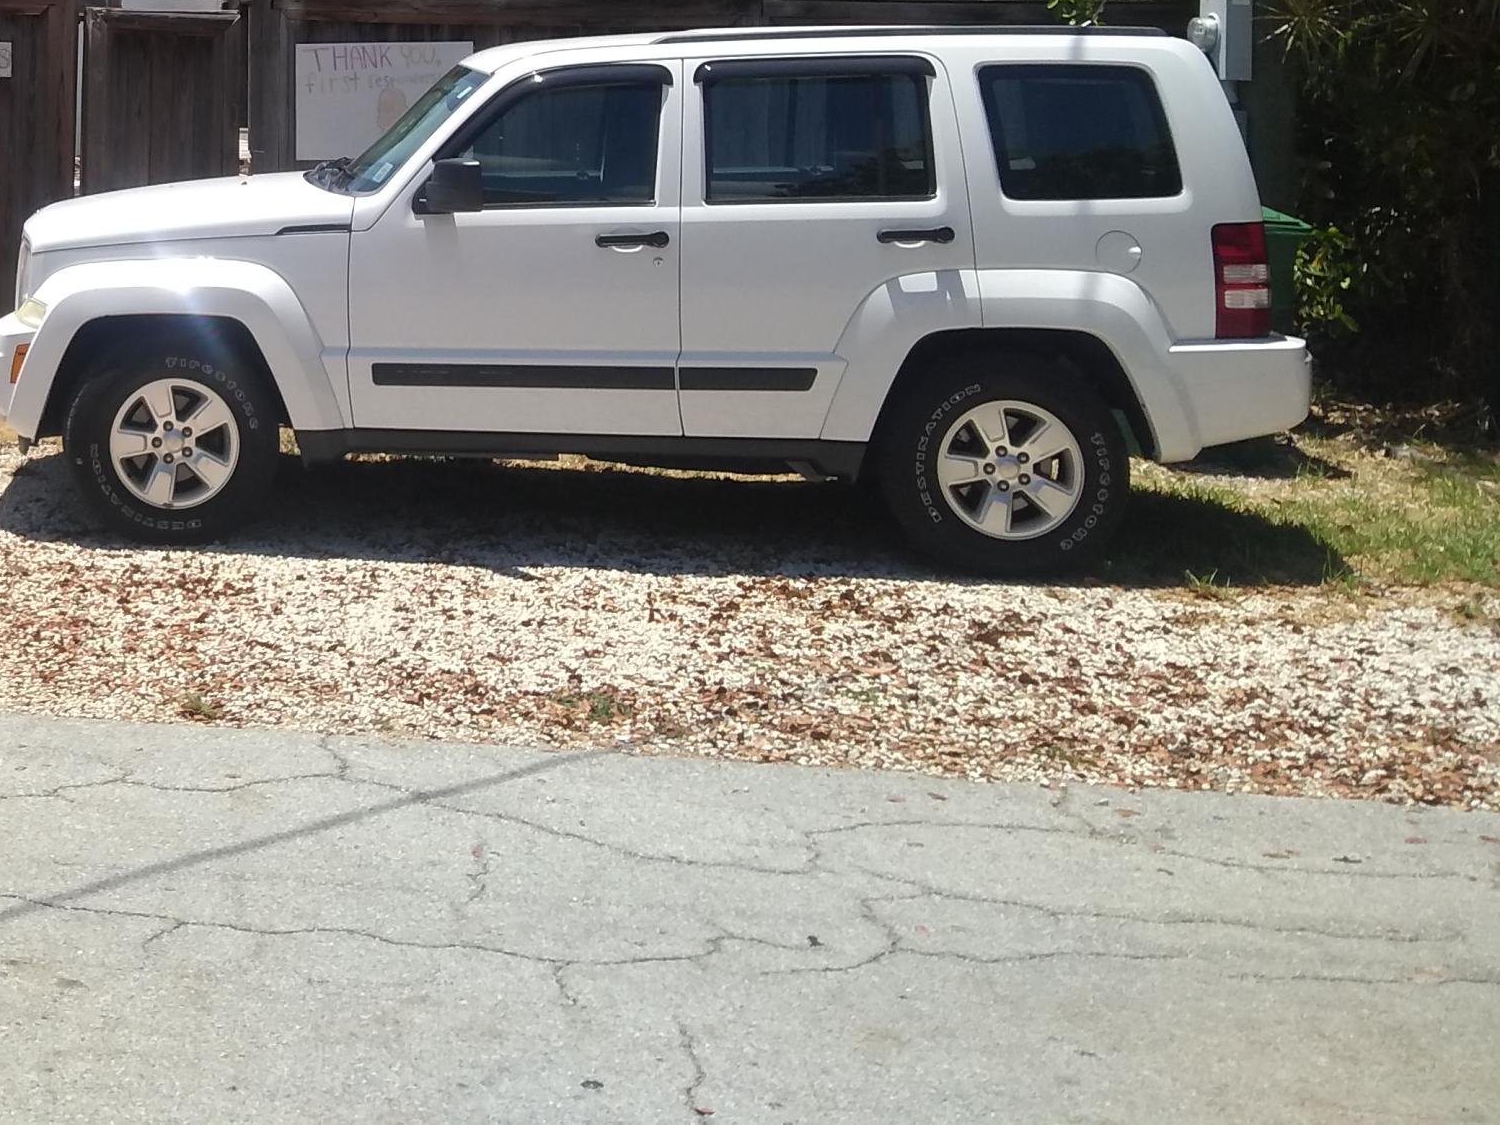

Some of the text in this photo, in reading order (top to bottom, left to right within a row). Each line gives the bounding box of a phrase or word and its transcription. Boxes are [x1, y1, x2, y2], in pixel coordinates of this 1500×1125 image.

[302, 45, 442, 72] THANK YOU,
[304, 70, 361, 95] first
[915, 383, 981, 523] DESTINATION
[89, 443, 203, 531] DESTINATION
